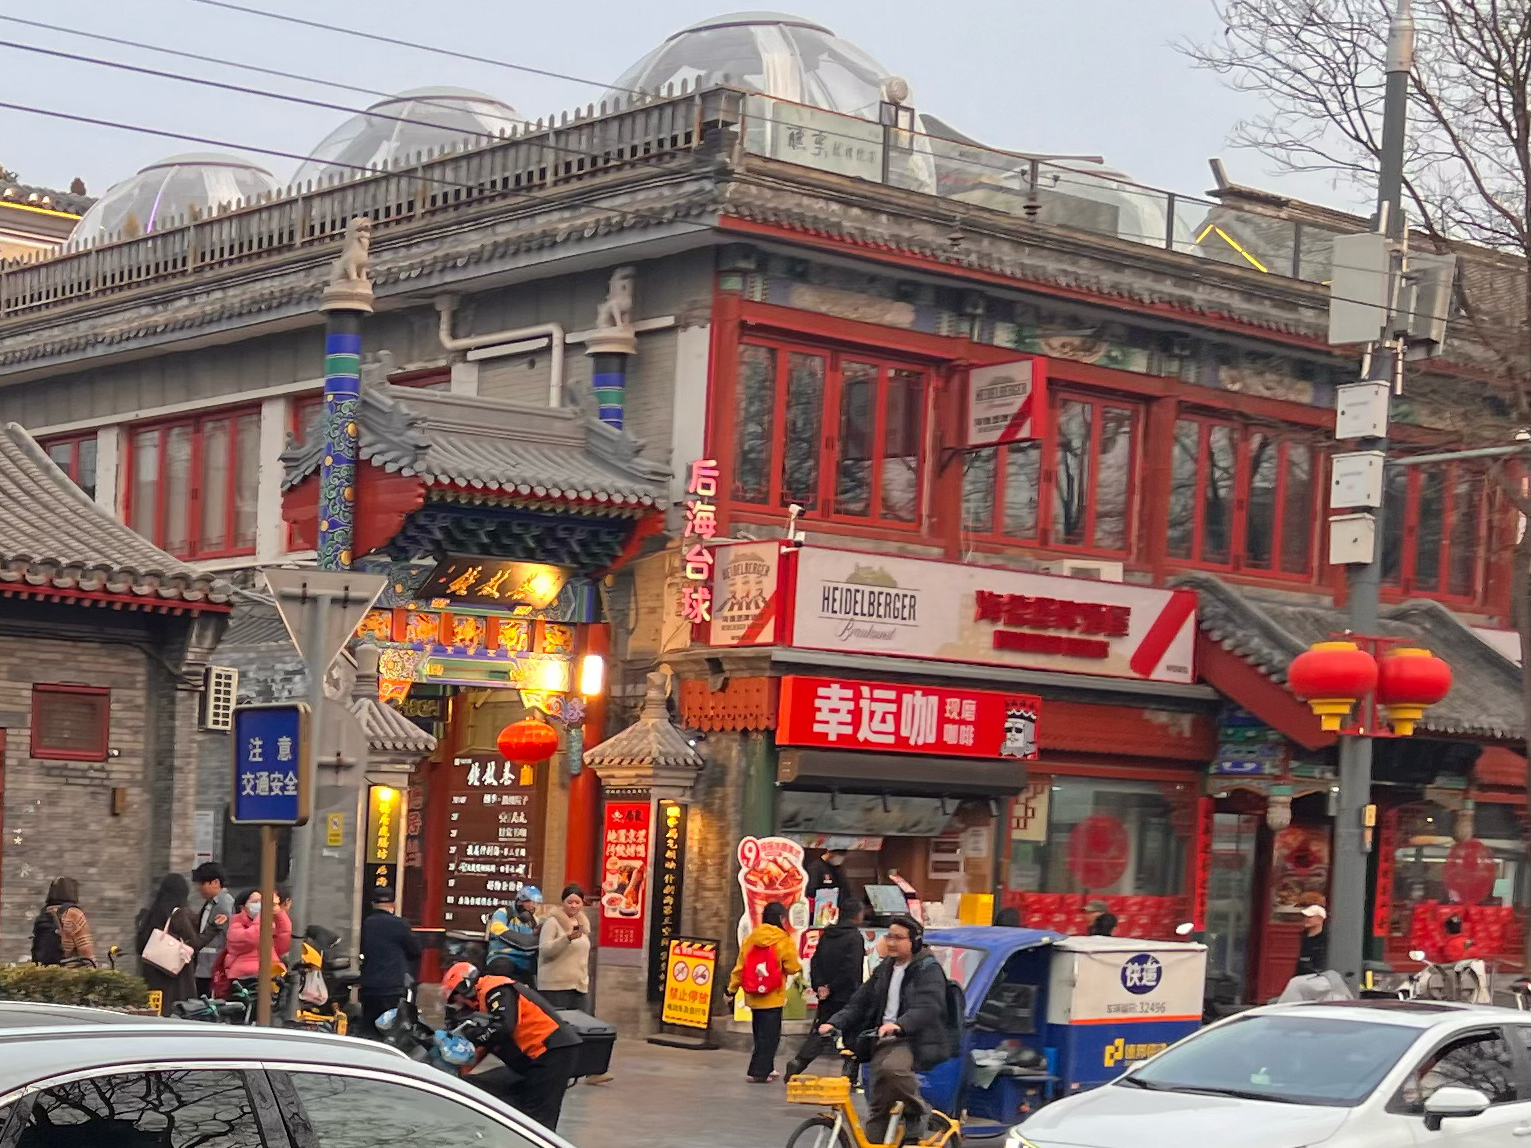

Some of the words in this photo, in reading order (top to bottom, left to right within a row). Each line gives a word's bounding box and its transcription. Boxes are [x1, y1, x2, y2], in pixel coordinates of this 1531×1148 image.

[681, 459, 720, 624] 后海台球
[820, 585, 917, 622] HEIDELBERGER
[813, 683, 940, 746] 幸运咖
[944, 697, 977, 721] 现磨
[248, 735, 292, 762] 注意
[241, 770, 299, 796] 交通安全
